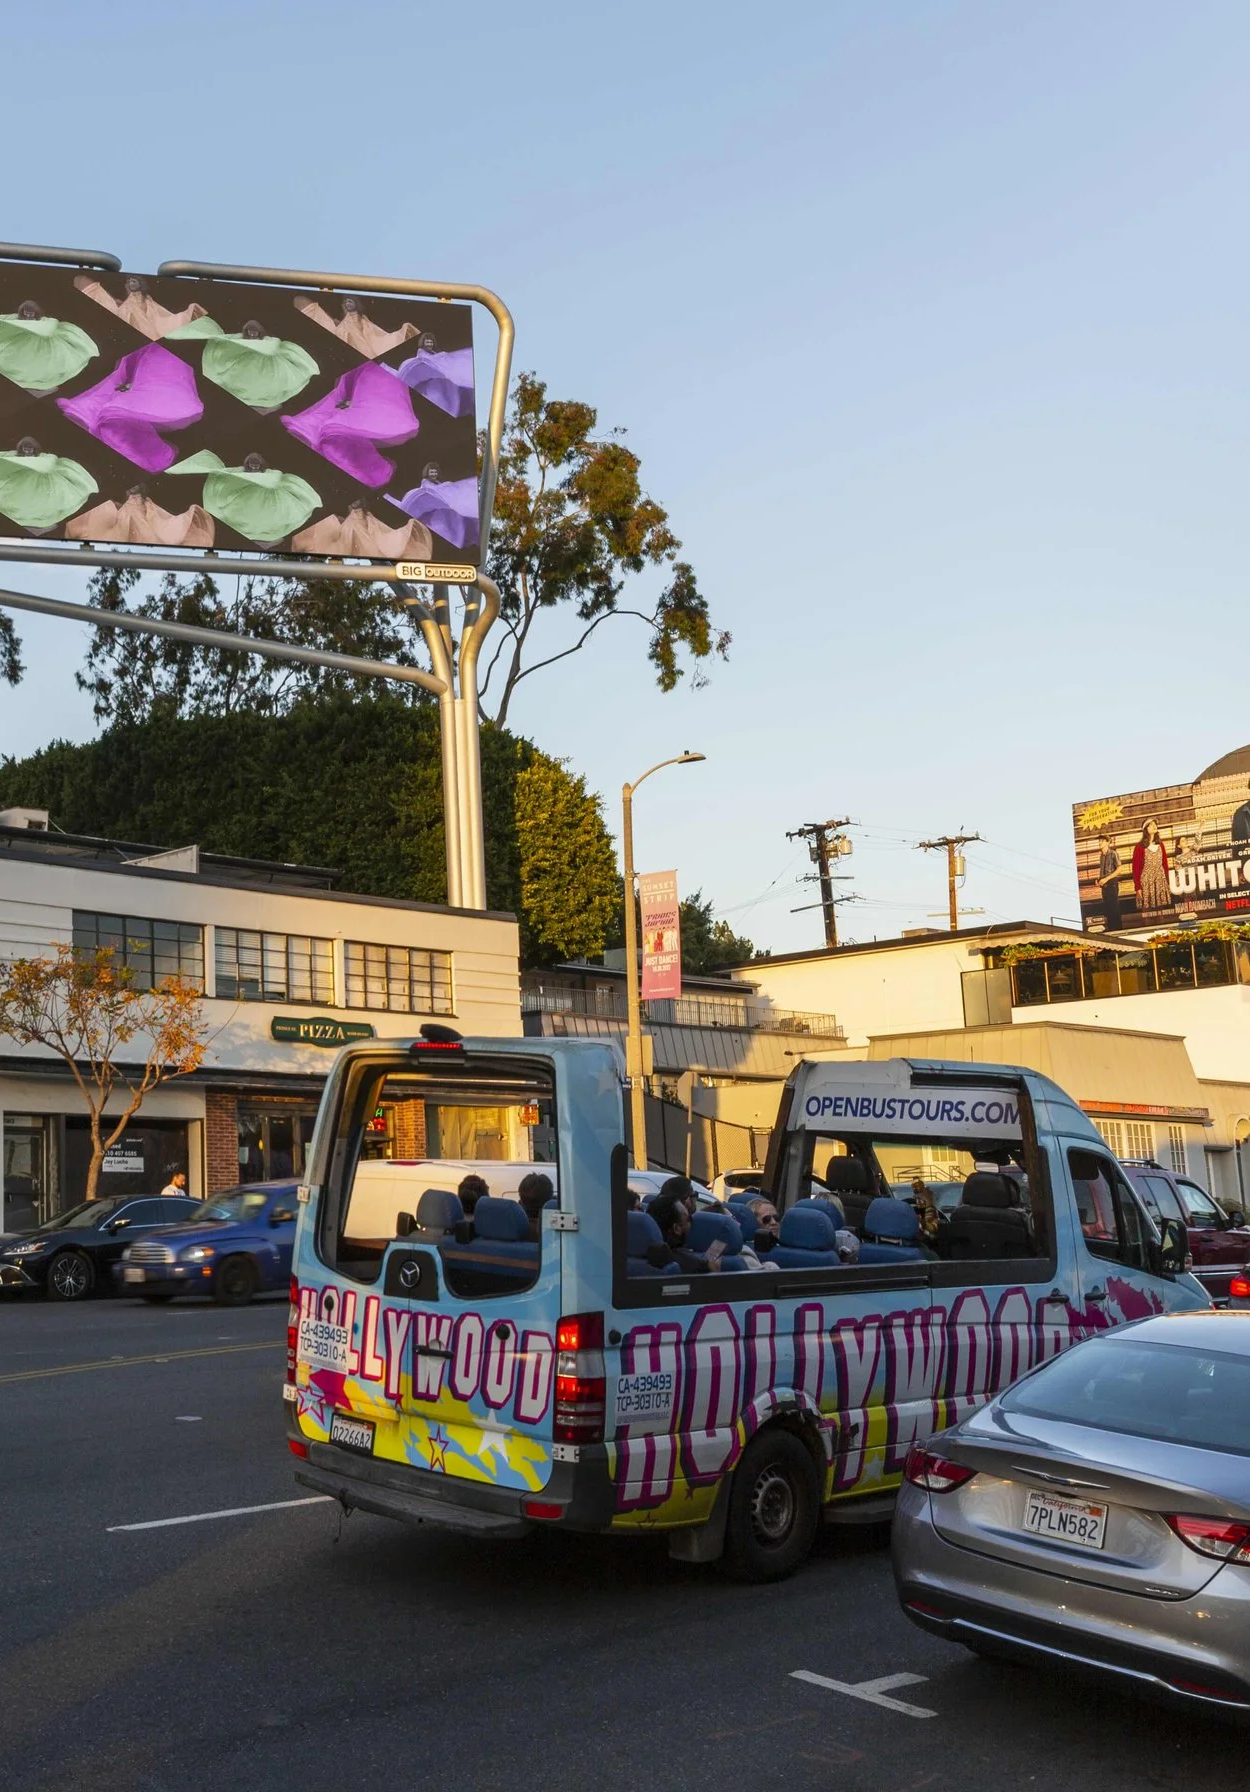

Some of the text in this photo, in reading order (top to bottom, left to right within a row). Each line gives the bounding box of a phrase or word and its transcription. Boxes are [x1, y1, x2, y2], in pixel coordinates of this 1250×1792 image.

[402, 565, 473, 578] BIG OUTDOOR
[642, 880, 675, 893] SUNSET
[1169, 859, 1250, 896] WHIT
[644, 893, 675, 904] STRIP
[299, 1023, 345, 1040] PIZZA
[805, 1095, 1022, 1125] OPENBUSTOURS.COM
[301, 1321, 348, 1345] CA-439493
[300, 1336, 347, 1363] TCP-30310-A
[618, 1374, 672, 1394] CA-439493
[332, 1425, 371, 1449] 02266A2
[1031, 1505, 1099, 1540] 7PLN582
